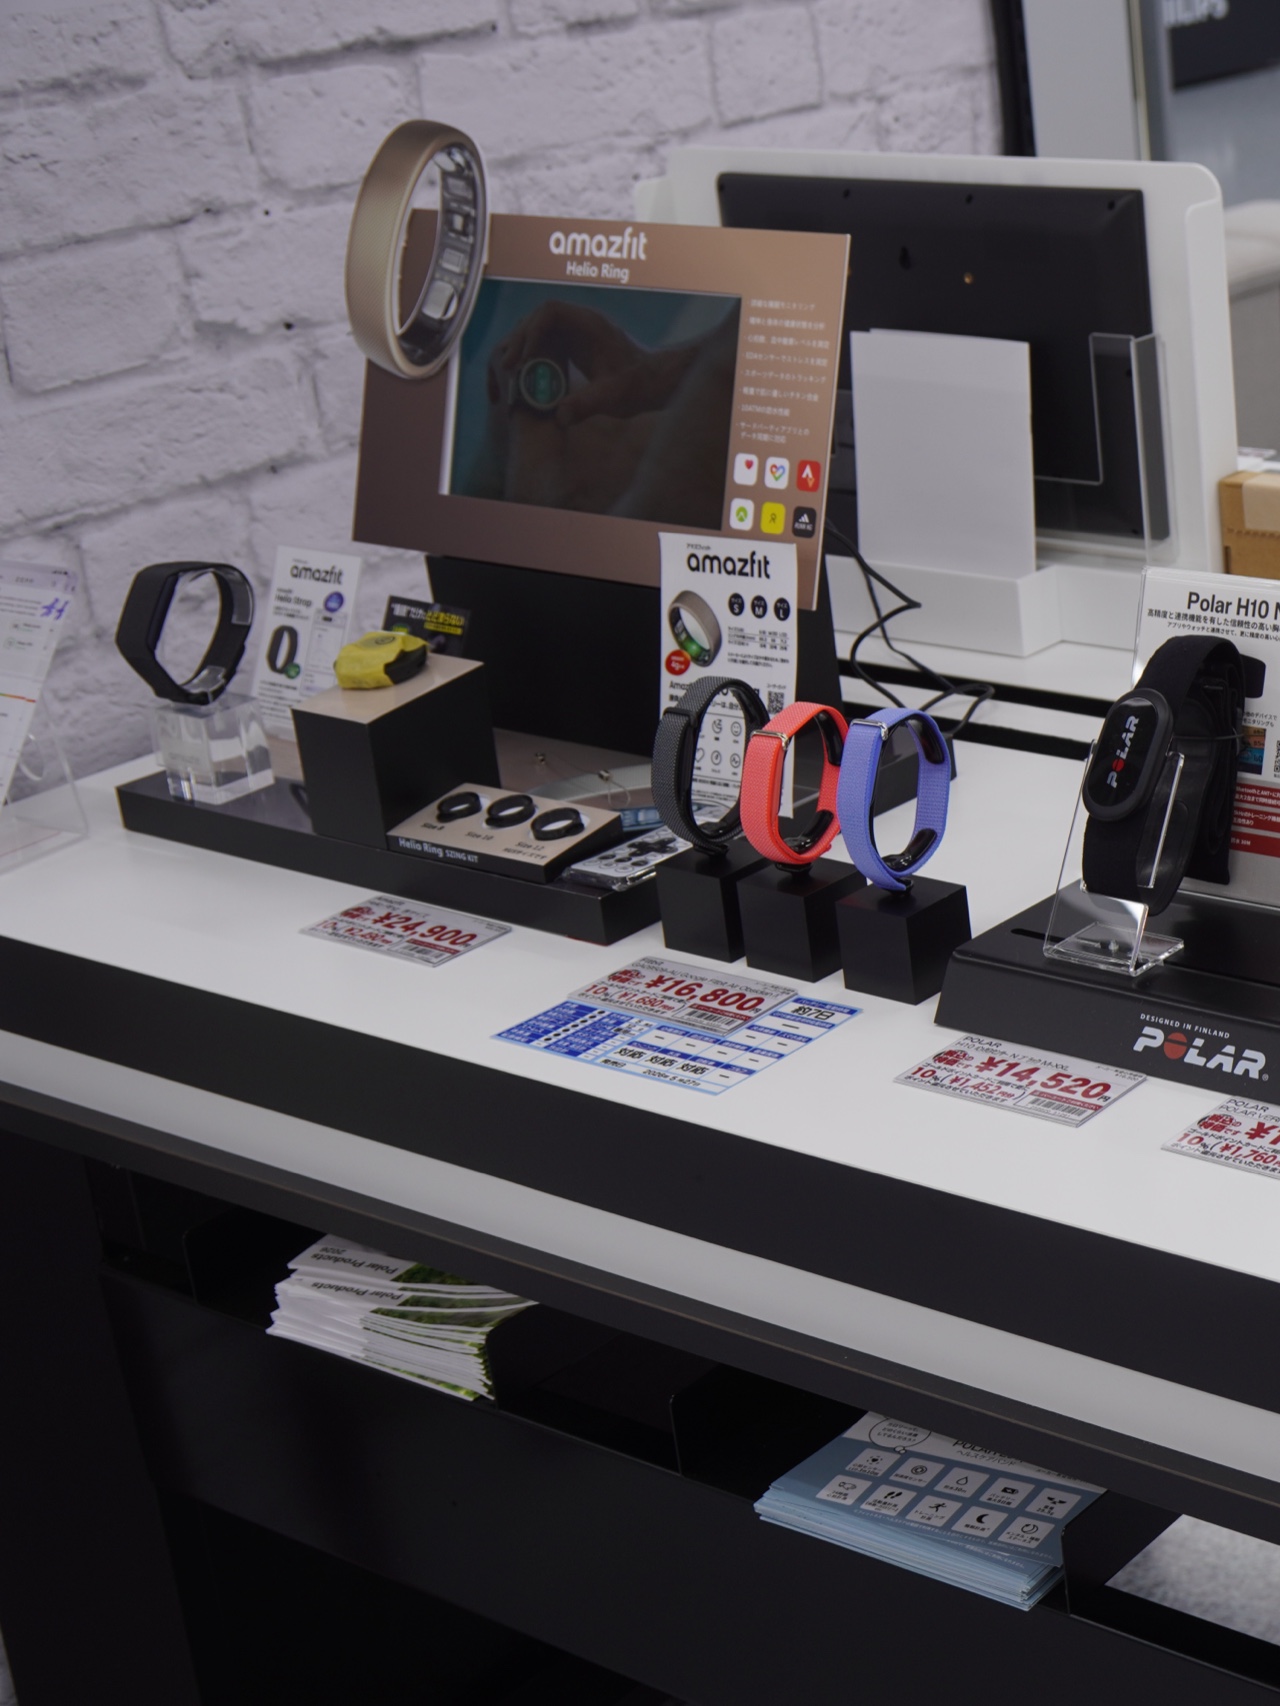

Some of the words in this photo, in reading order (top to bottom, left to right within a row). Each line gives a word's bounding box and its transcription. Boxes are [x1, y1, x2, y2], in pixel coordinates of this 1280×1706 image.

[548, 226, 648, 261] amazfit
[566, 260, 598, 277] Helio
[600, 263, 630, 284] Ring
[687, 551, 770, 579] amazfit
[290, 563, 344, 585] amazfit
[733, 604, 740, 614] S
[754, 607, 764, 616] M
[779, 608, 785, 619] L
[1187, 591, 1232, 615] Polar
[1235, 597, 1270, 620] H10
[1106, 714, 1140, 788] POLAR
[398, 838, 422, 851] Helio
[423, 843, 444, 858] Ring
[467, 854, 480, 864] KIT
[791, 1005, 836, 1021] 約7日
[1140, 1013, 1180, 1028] DESIGNED
[1182, 1023, 1192, 1031] IN
[1194, 1025, 1231, 1039] FINLAND
[963, 1036, 1003, 1048] POLAR
[1133, 1026, 1266, 1079] POLAR
[975, 1056, 1111, 1103] ¥14,520円
[1219, 1105, 1257, 1118] POLAR
[1226, 1099, 1270, 1113] POLAR
[310, 1253, 364, 1268] Products
[364, 1263, 400, 1275] Polar
[311, 1281, 367, 1297] Products
[369, 1290, 404, 1301] Polar
[957, 1450, 1017, 1466] ヘルスケアバンド
